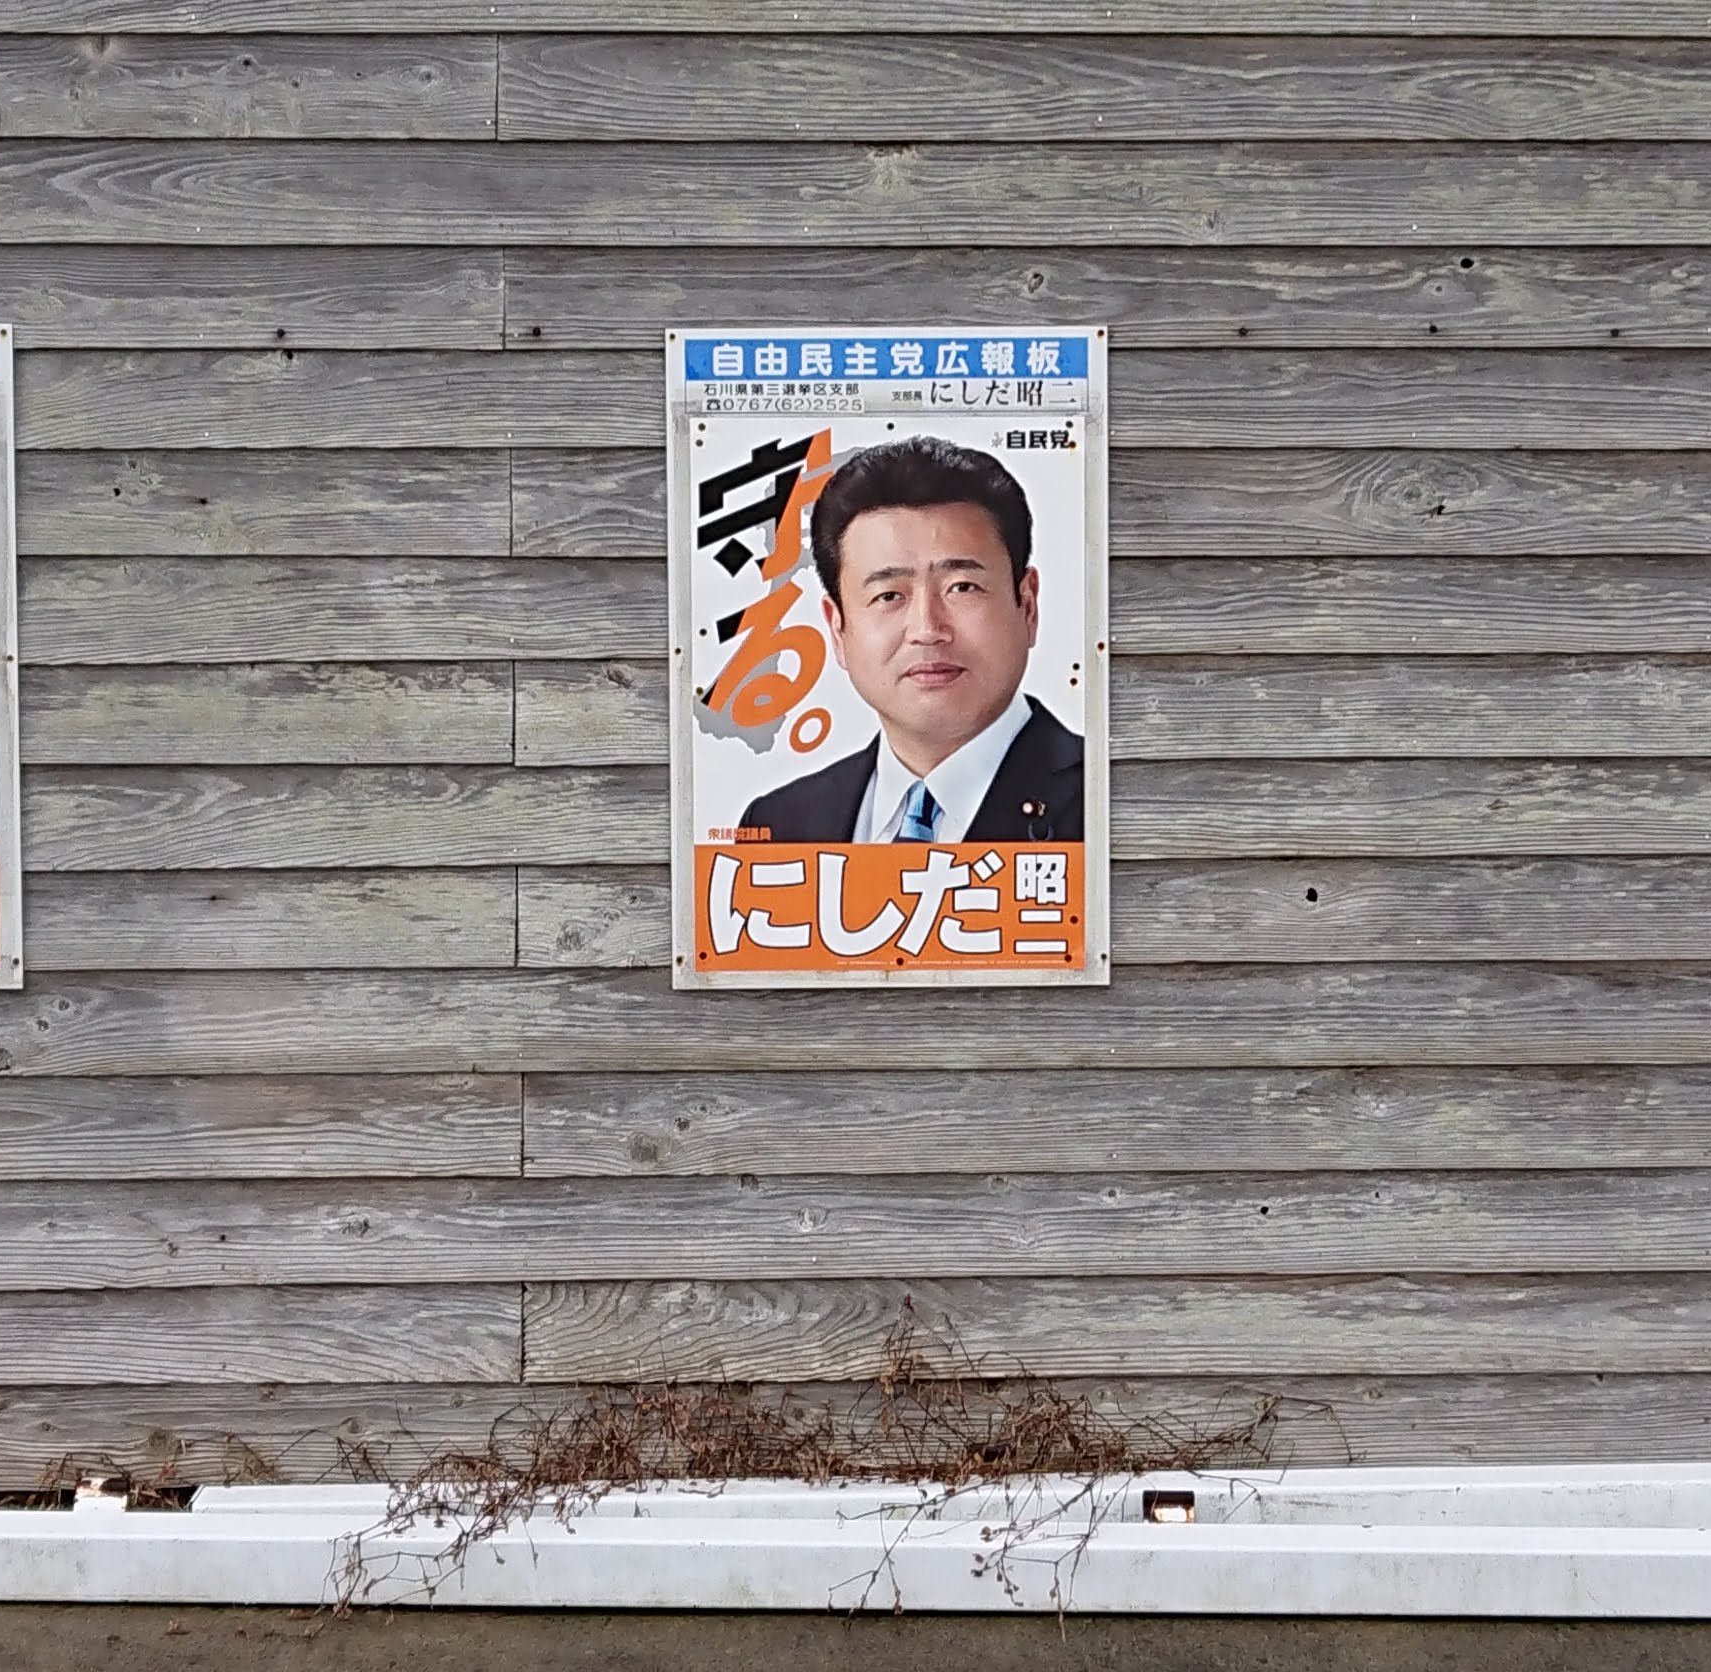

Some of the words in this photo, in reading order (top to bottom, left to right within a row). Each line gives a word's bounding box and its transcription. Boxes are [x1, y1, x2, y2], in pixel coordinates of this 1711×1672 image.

[711, 341, 1062, 377] 自由民主党広報板
[703, 383, 860, 396] 石川県第三選挙区支部
[930, 380, 1076, 407] にしだ昭二
[723, 398, 862, 411] 0767(62)2525
[1006, 430, 1070, 449] 自民党
[697, 427, 832, 754] 守る。
[707, 849, 1006, 957] にしだ
[1013, 852, 1069, 955] 昭二
